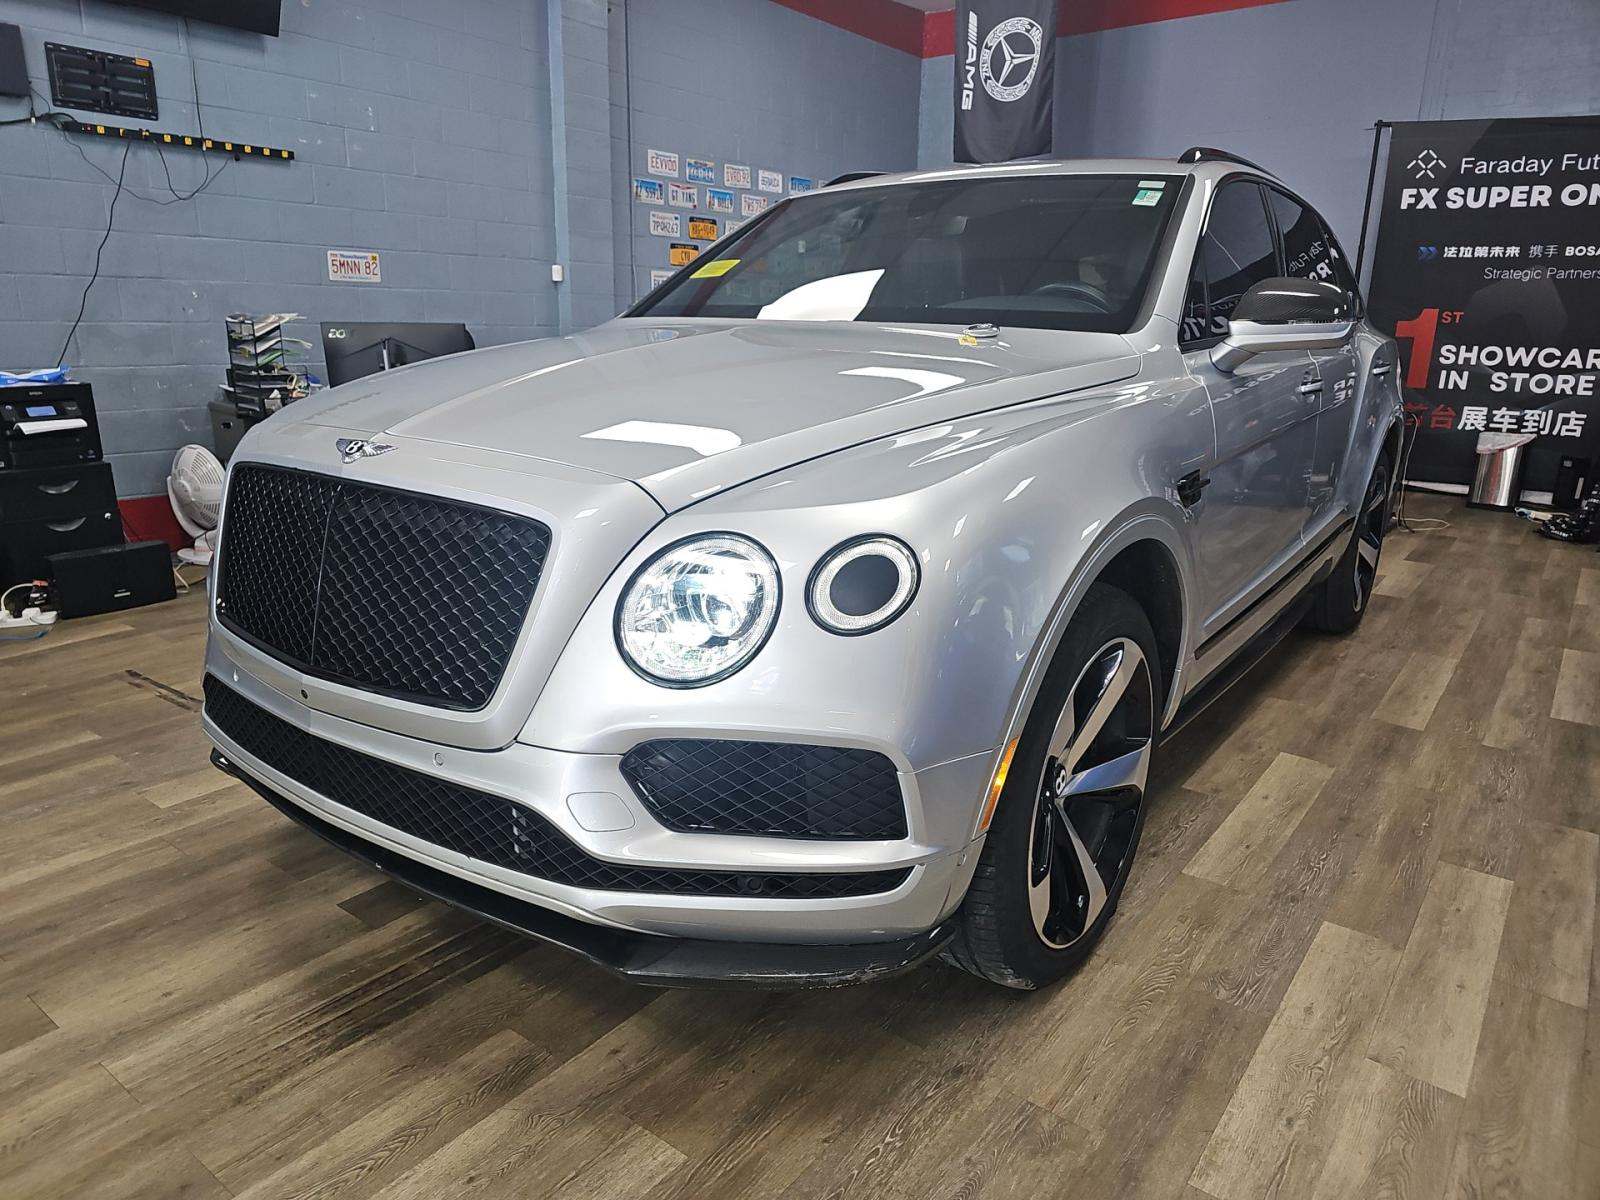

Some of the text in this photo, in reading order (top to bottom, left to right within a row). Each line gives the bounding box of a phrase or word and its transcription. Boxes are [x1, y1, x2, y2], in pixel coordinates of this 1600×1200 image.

[961, 41, 977, 111] AMG
[1460, 153, 1600, 177] Faraday Fut
[1400, 188, 1440, 210] FX
[1445, 185, 1553, 210] SUPER
[331, 259, 378, 276] 5MNN 82
[1483, 266, 1542, 282] Strategic
[1395, 308, 1464, 389] 1 ST
[1438, 344, 1600, 370] SHOWCAR
[1437, 370, 1596, 396] IN STORE
